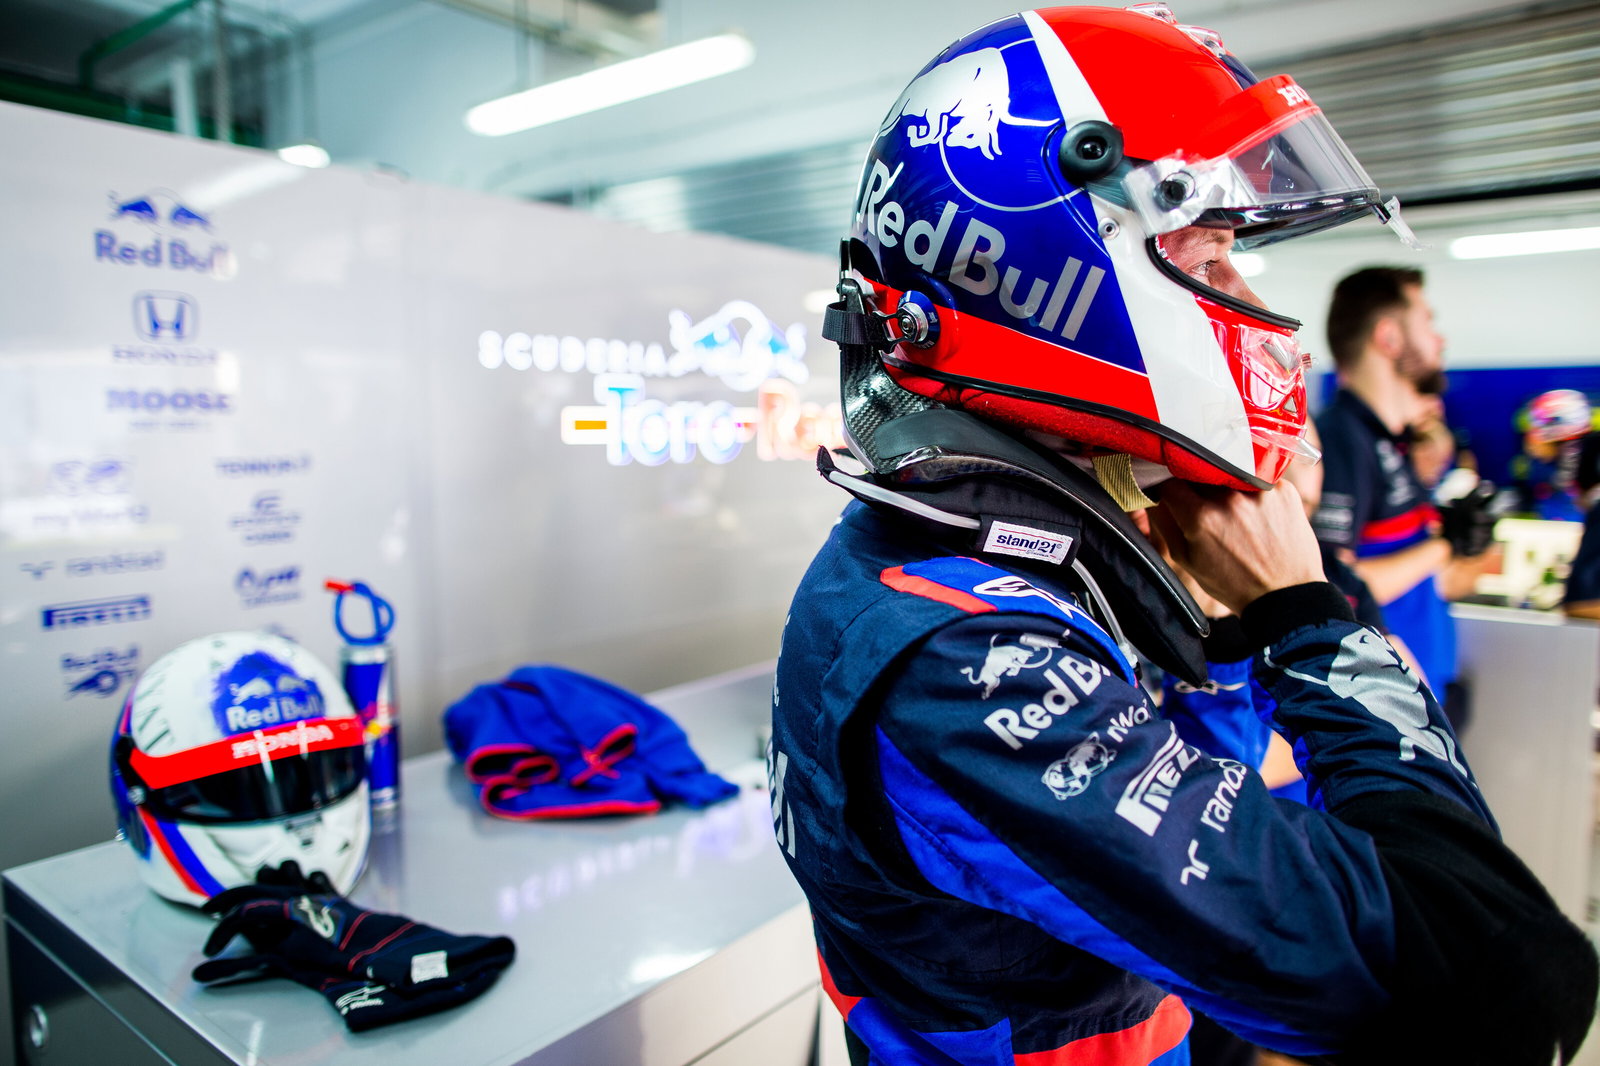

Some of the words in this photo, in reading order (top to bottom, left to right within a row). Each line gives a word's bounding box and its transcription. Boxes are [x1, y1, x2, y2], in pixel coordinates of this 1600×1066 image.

[94, 227, 163, 269] Red
[856, 158, 960, 274] Red
[948, 217, 1107, 342] Bull
[225, 697, 280, 732] Red
[984, 669, 1079, 750] Red
